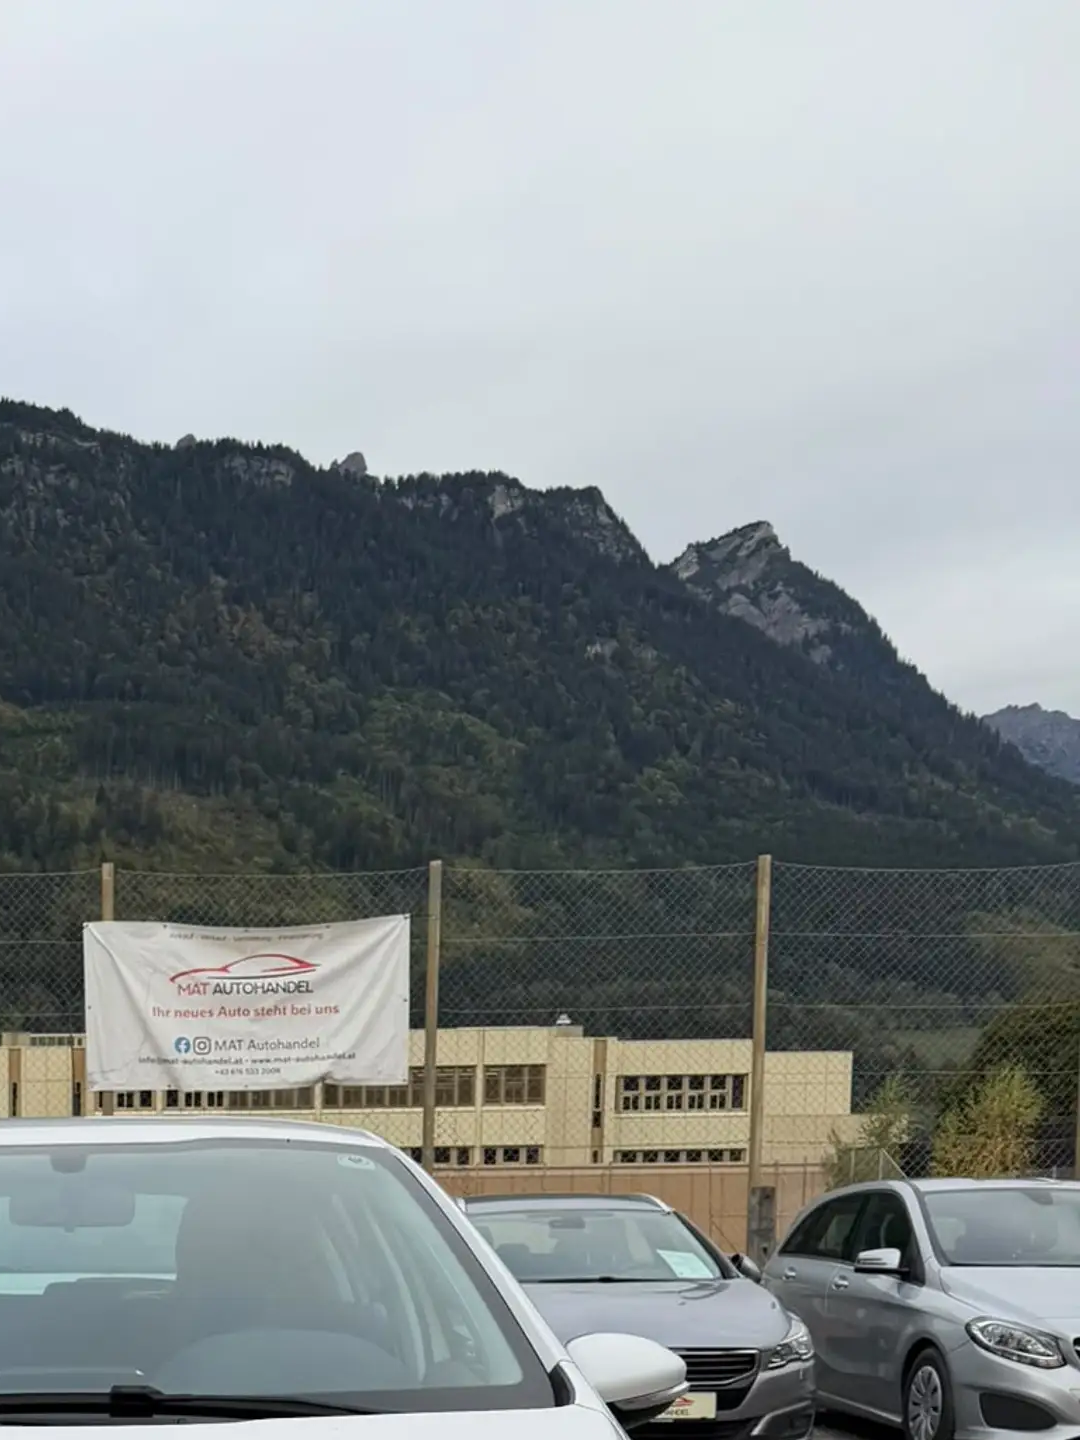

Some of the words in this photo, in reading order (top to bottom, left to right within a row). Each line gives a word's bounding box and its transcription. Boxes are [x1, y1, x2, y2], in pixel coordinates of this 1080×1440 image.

[177, 981, 210, 996] MAT
[212, 980, 314, 996] AUTOHANDEL
[152, 1005, 171, 1018] Ihr
[173, 1007, 214, 1019] neues
[216, 1004, 251, 1018] Auto
[253, 1004, 288, 1018] steht
[290, 1003, 312, 1016] bei
[314, 1004, 340, 1016] uns
[214, 1039, 245, 1051] MAT
[247, 1036, 320, 1051] Autohandel
